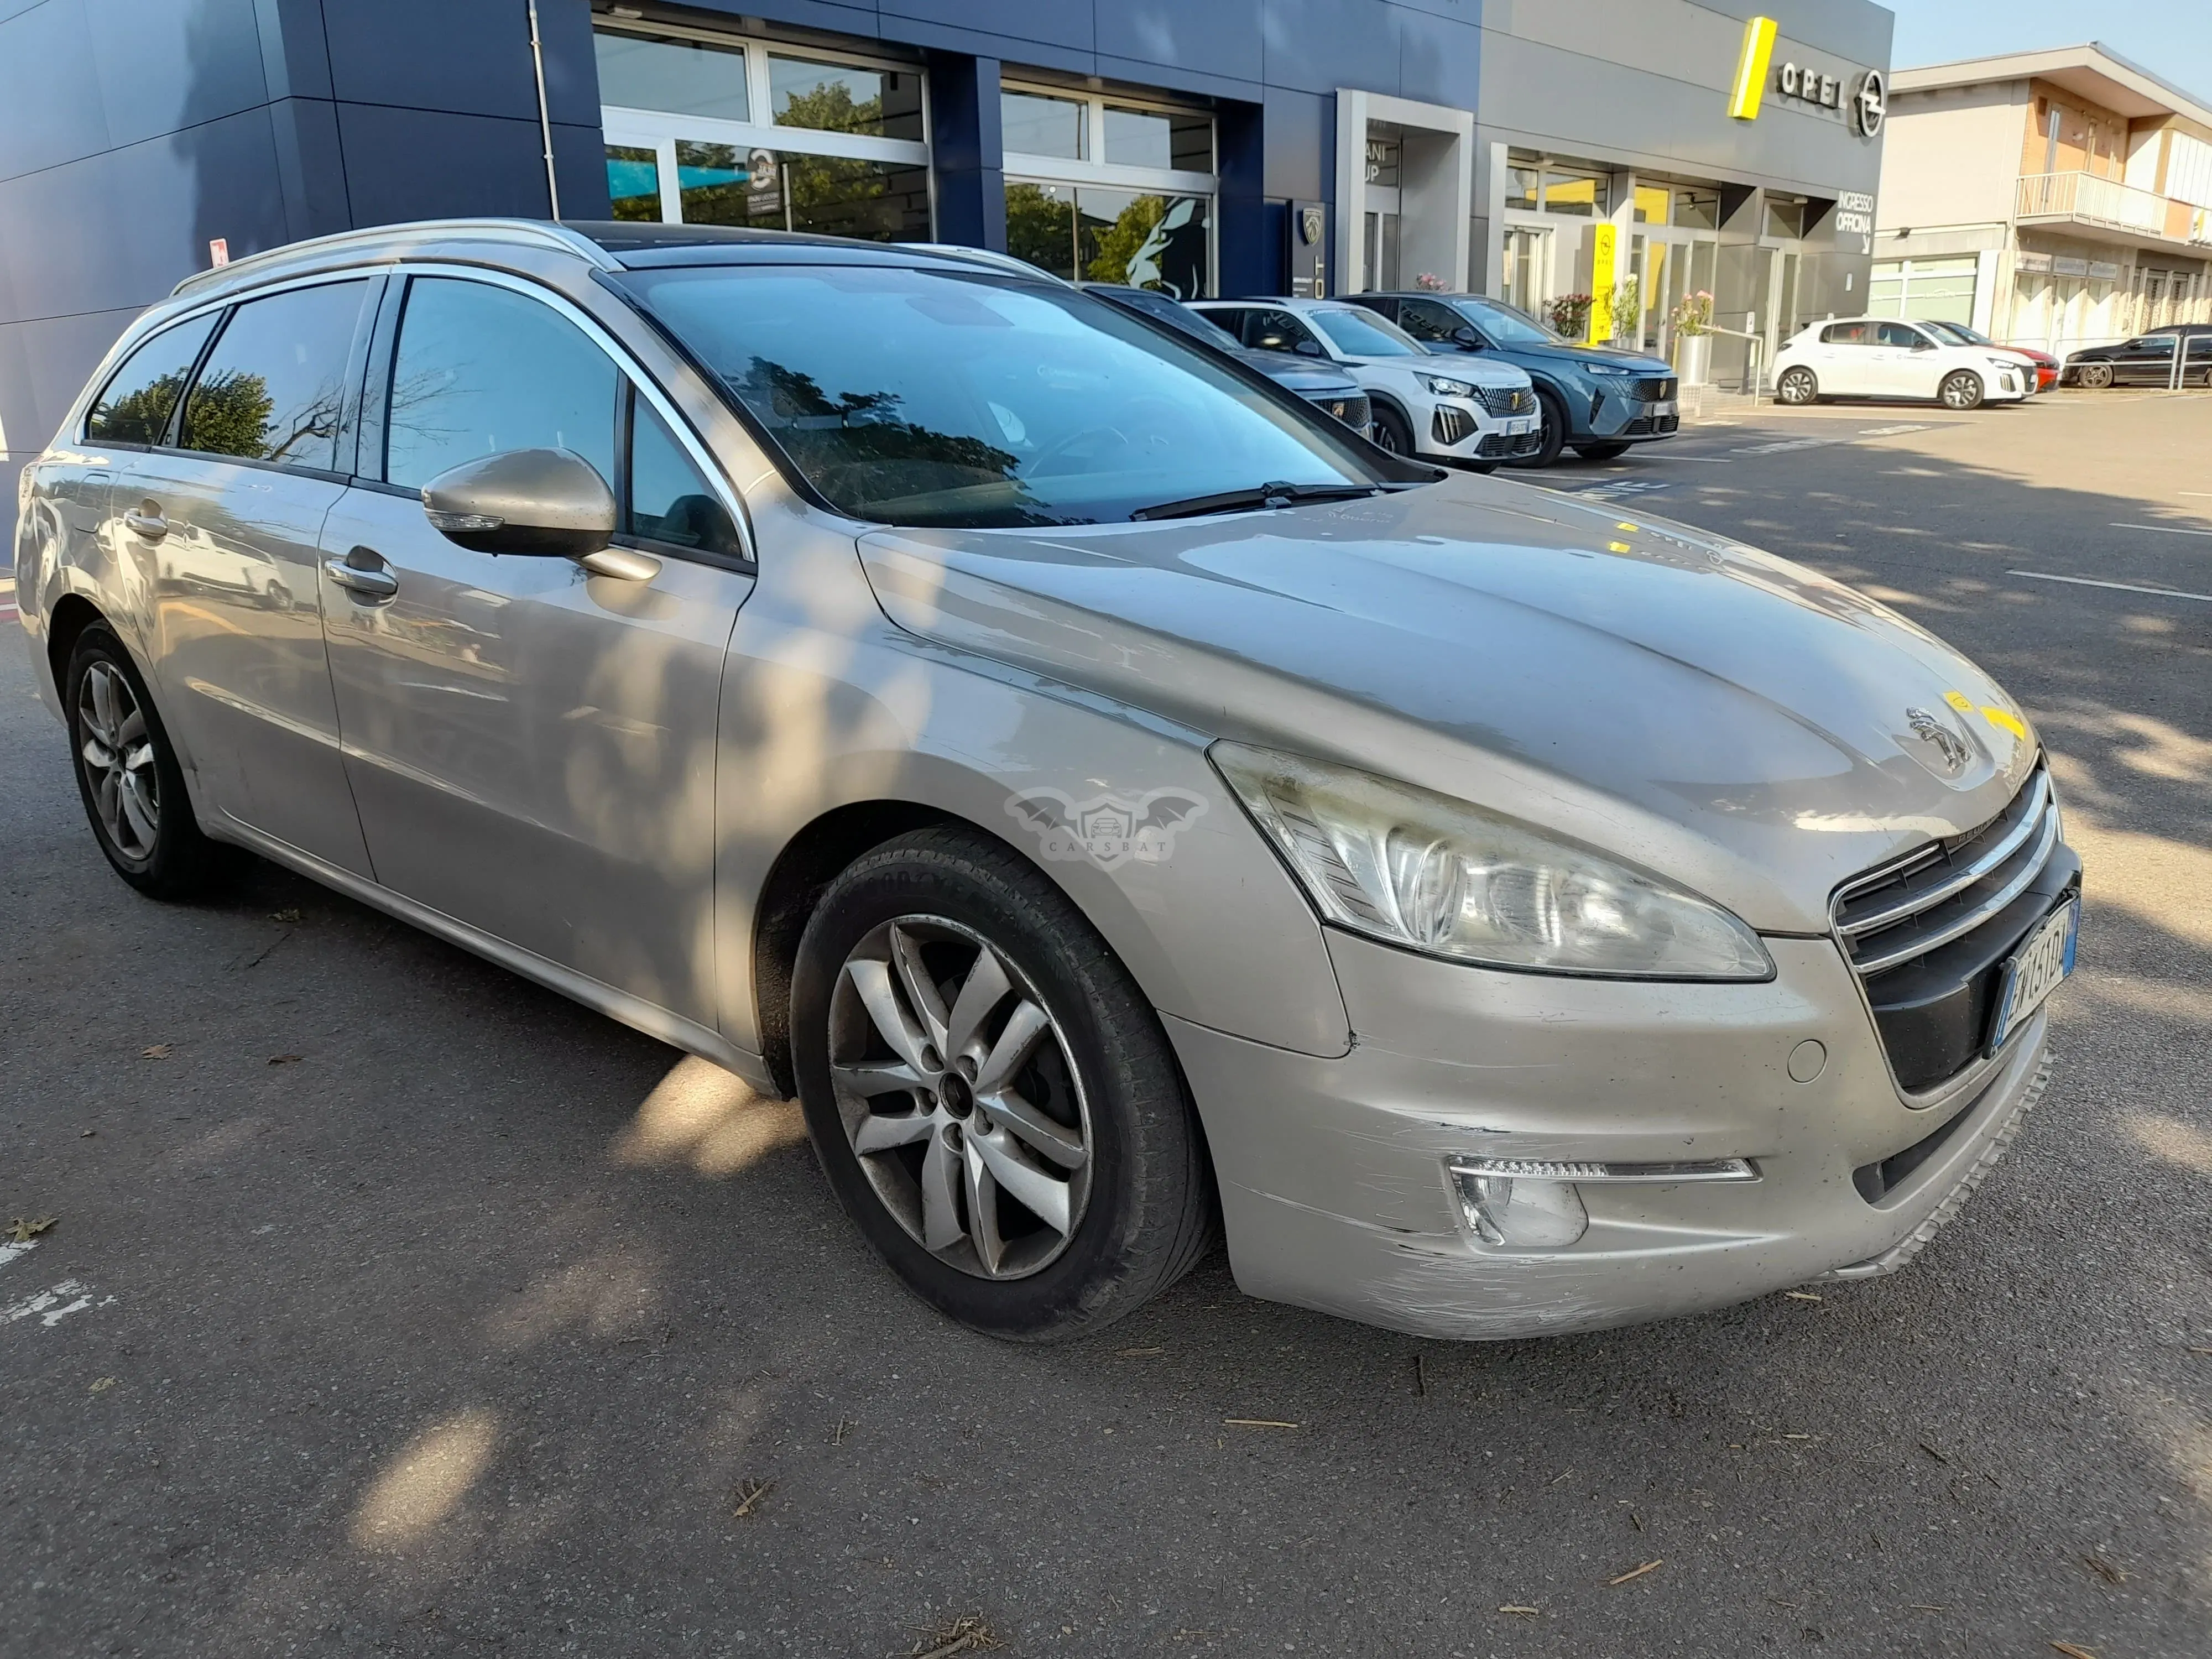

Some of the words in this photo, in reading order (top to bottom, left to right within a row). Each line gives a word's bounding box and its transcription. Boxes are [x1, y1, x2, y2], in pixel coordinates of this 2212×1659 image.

[1782, 61, 1848, 110] OPEL
[1838, 190, 1873, 212] INGRESSO
[1836, 211, 1871, 234] OFFICINA
